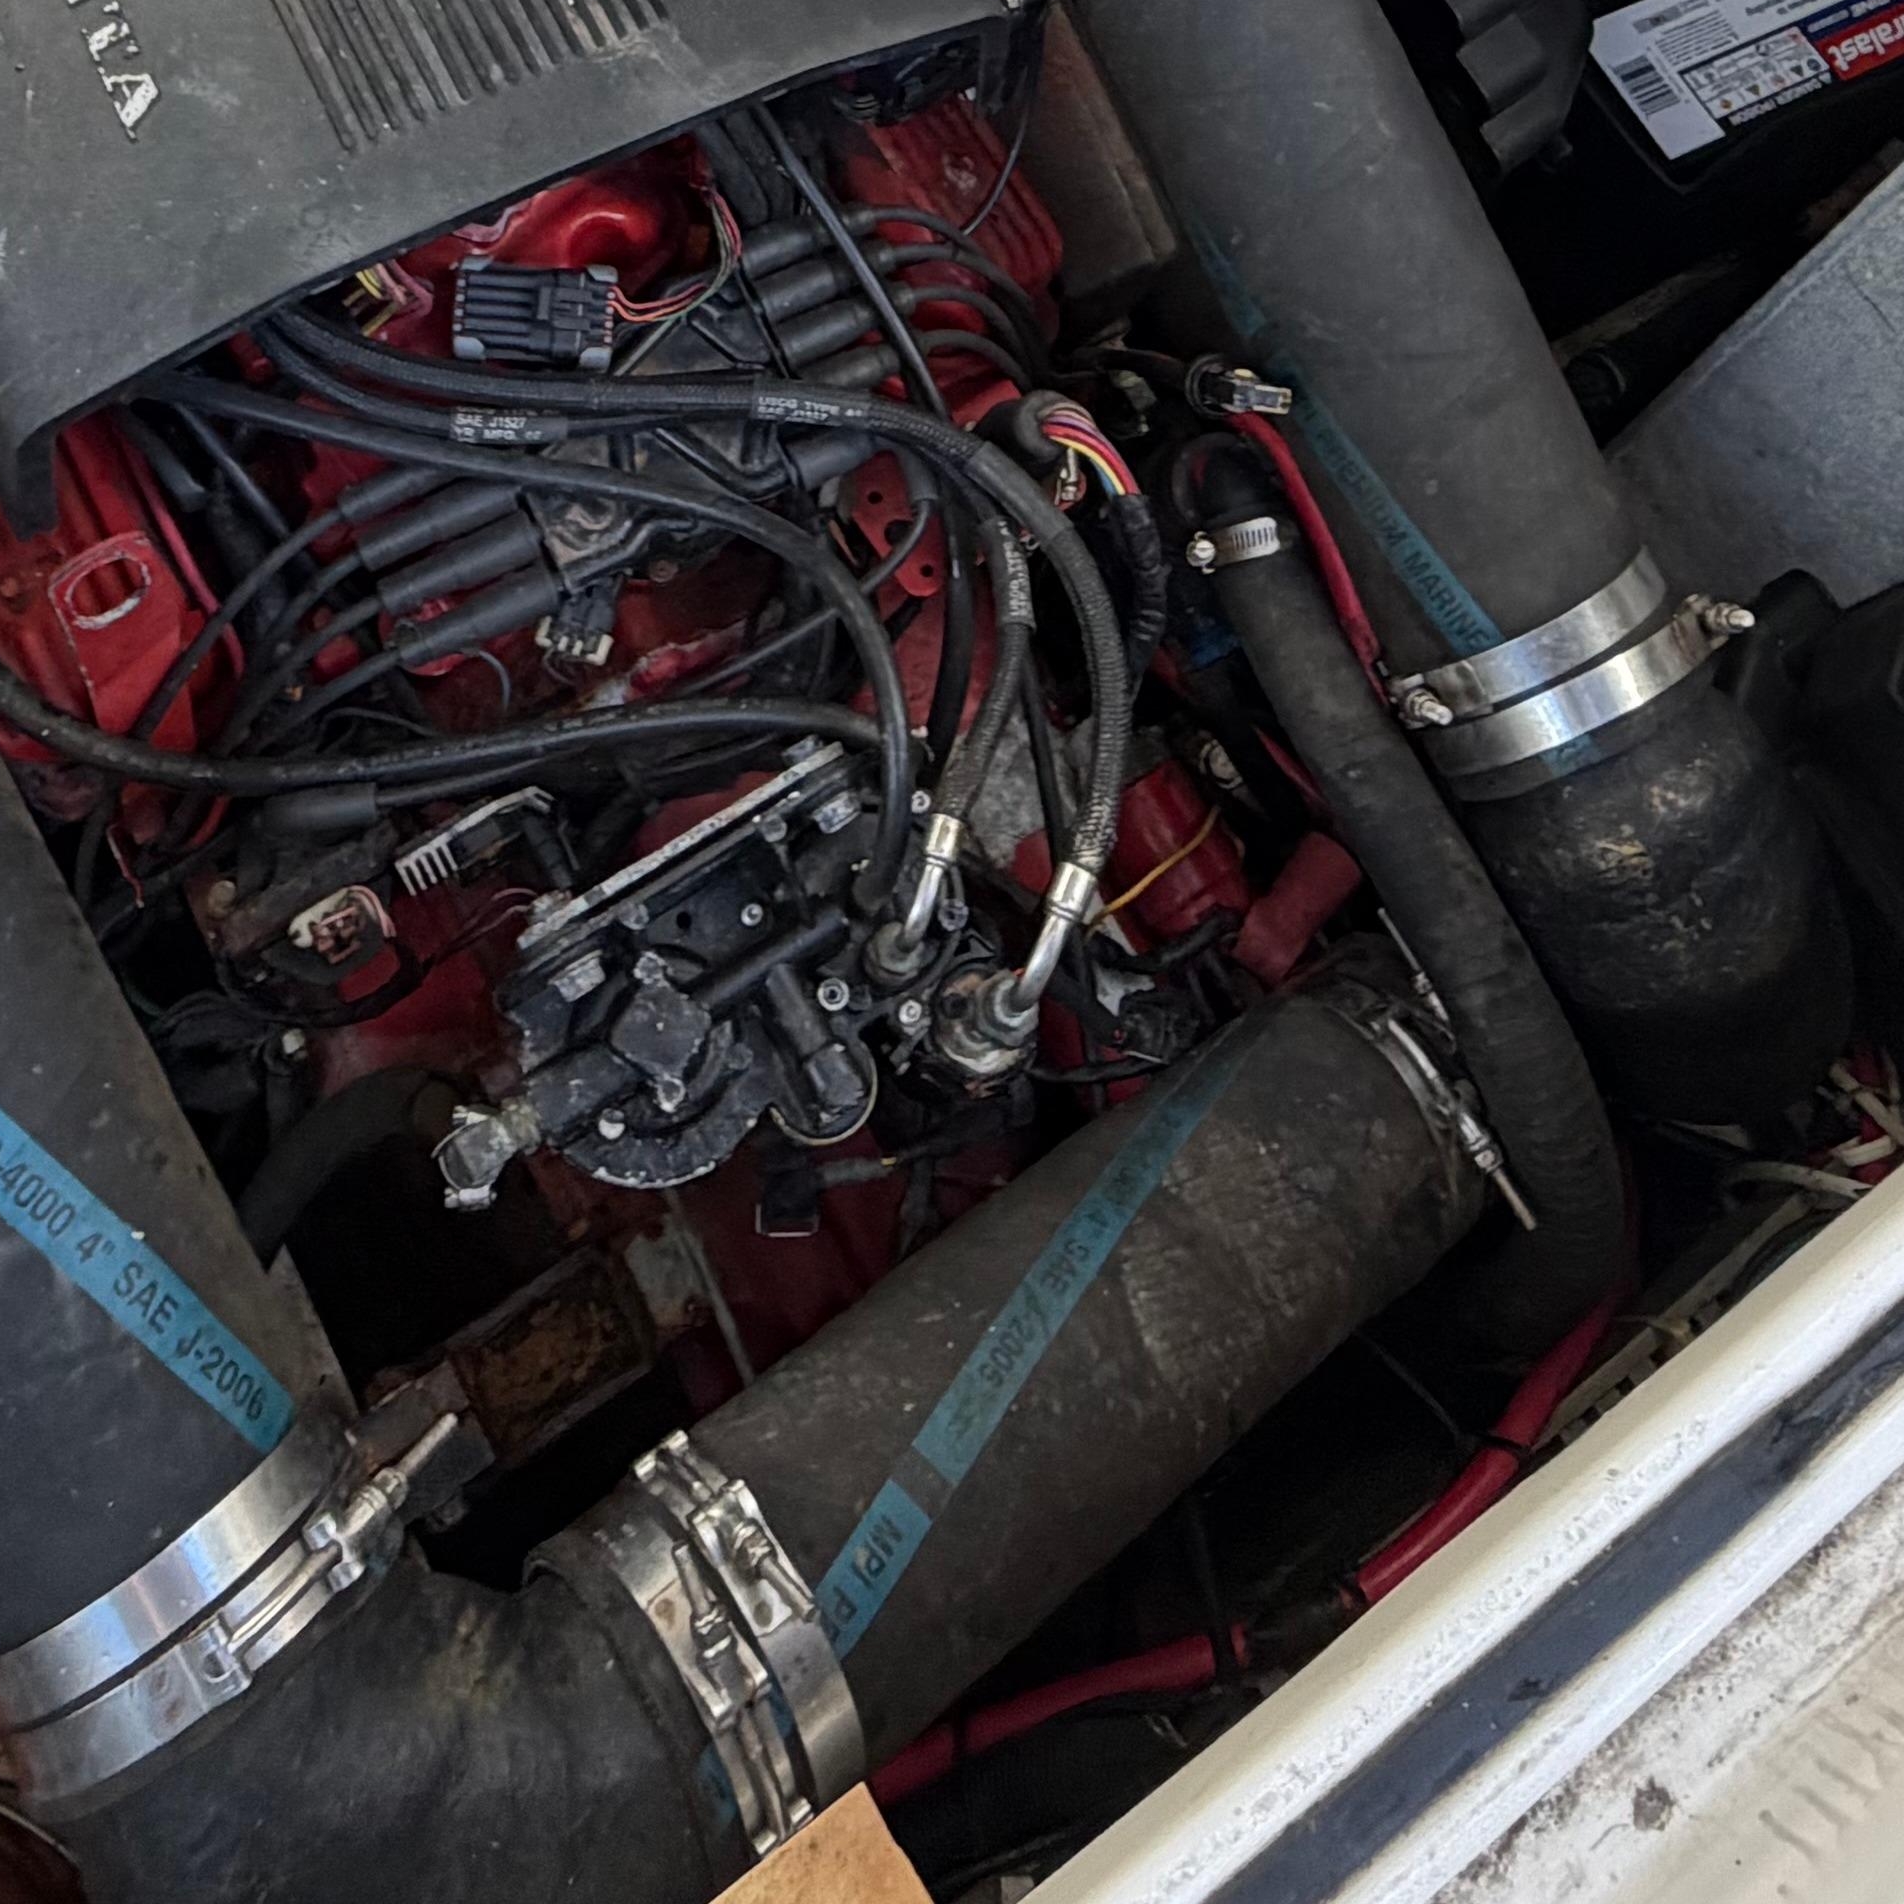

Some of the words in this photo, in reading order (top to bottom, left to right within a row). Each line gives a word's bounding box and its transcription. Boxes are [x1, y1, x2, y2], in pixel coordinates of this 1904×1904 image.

[454, 413, 482, 426] SAE
[488, 416, 526, 427] J1527
[803, 401, 839, 414] TYPE
[1402, 551, 1488, 654] MARINE
[70, 1229, 116, 1268] 4"
[109, 1260, 183, 1335] SAE
[171, 1329, 274, 1422] J-2006
[846, 1512, 904, 1590] MPI
